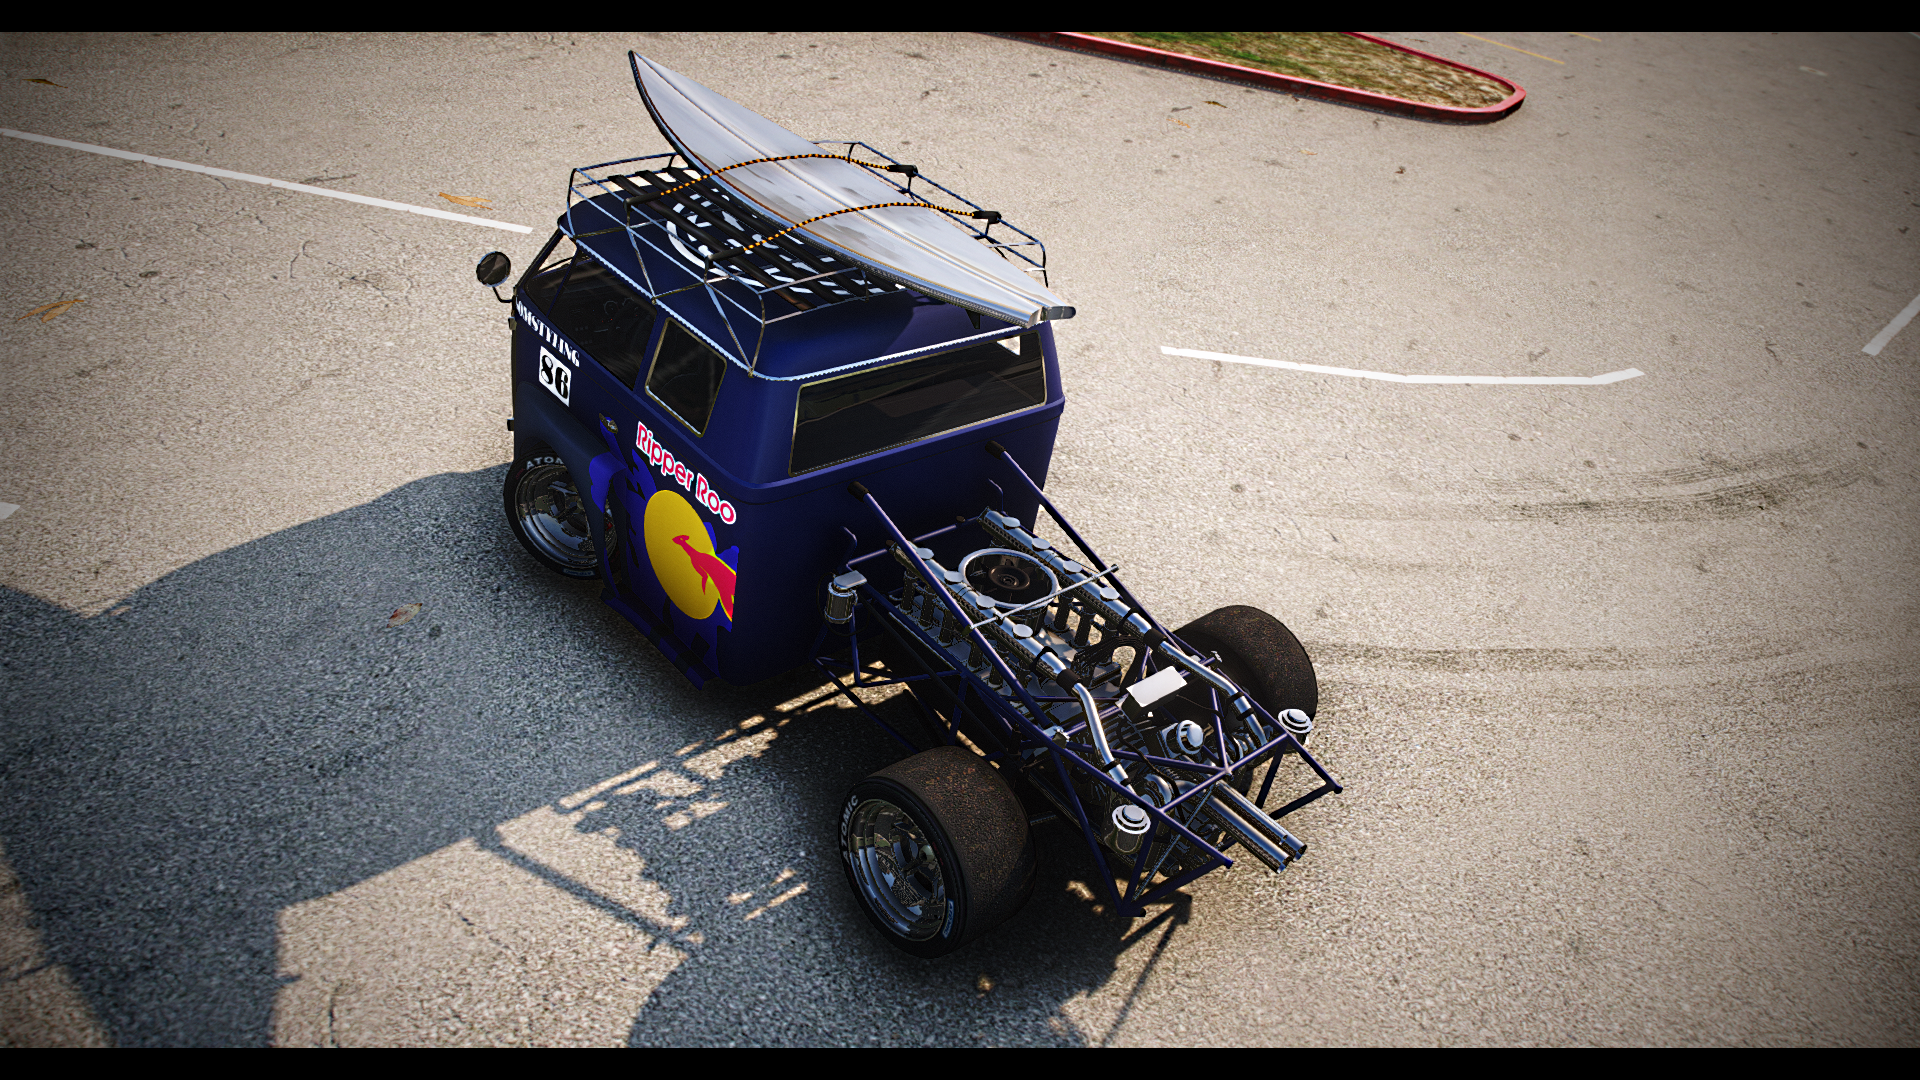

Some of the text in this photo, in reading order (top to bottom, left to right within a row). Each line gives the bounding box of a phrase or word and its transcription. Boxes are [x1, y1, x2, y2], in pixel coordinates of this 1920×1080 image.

[515, 295, 580, 367] OMSTYLING
[541, 354, 569, 400] 86
[636, 421, 736, 525] Ripper Roo
[841, 794, 859, 865] ATOMIC
